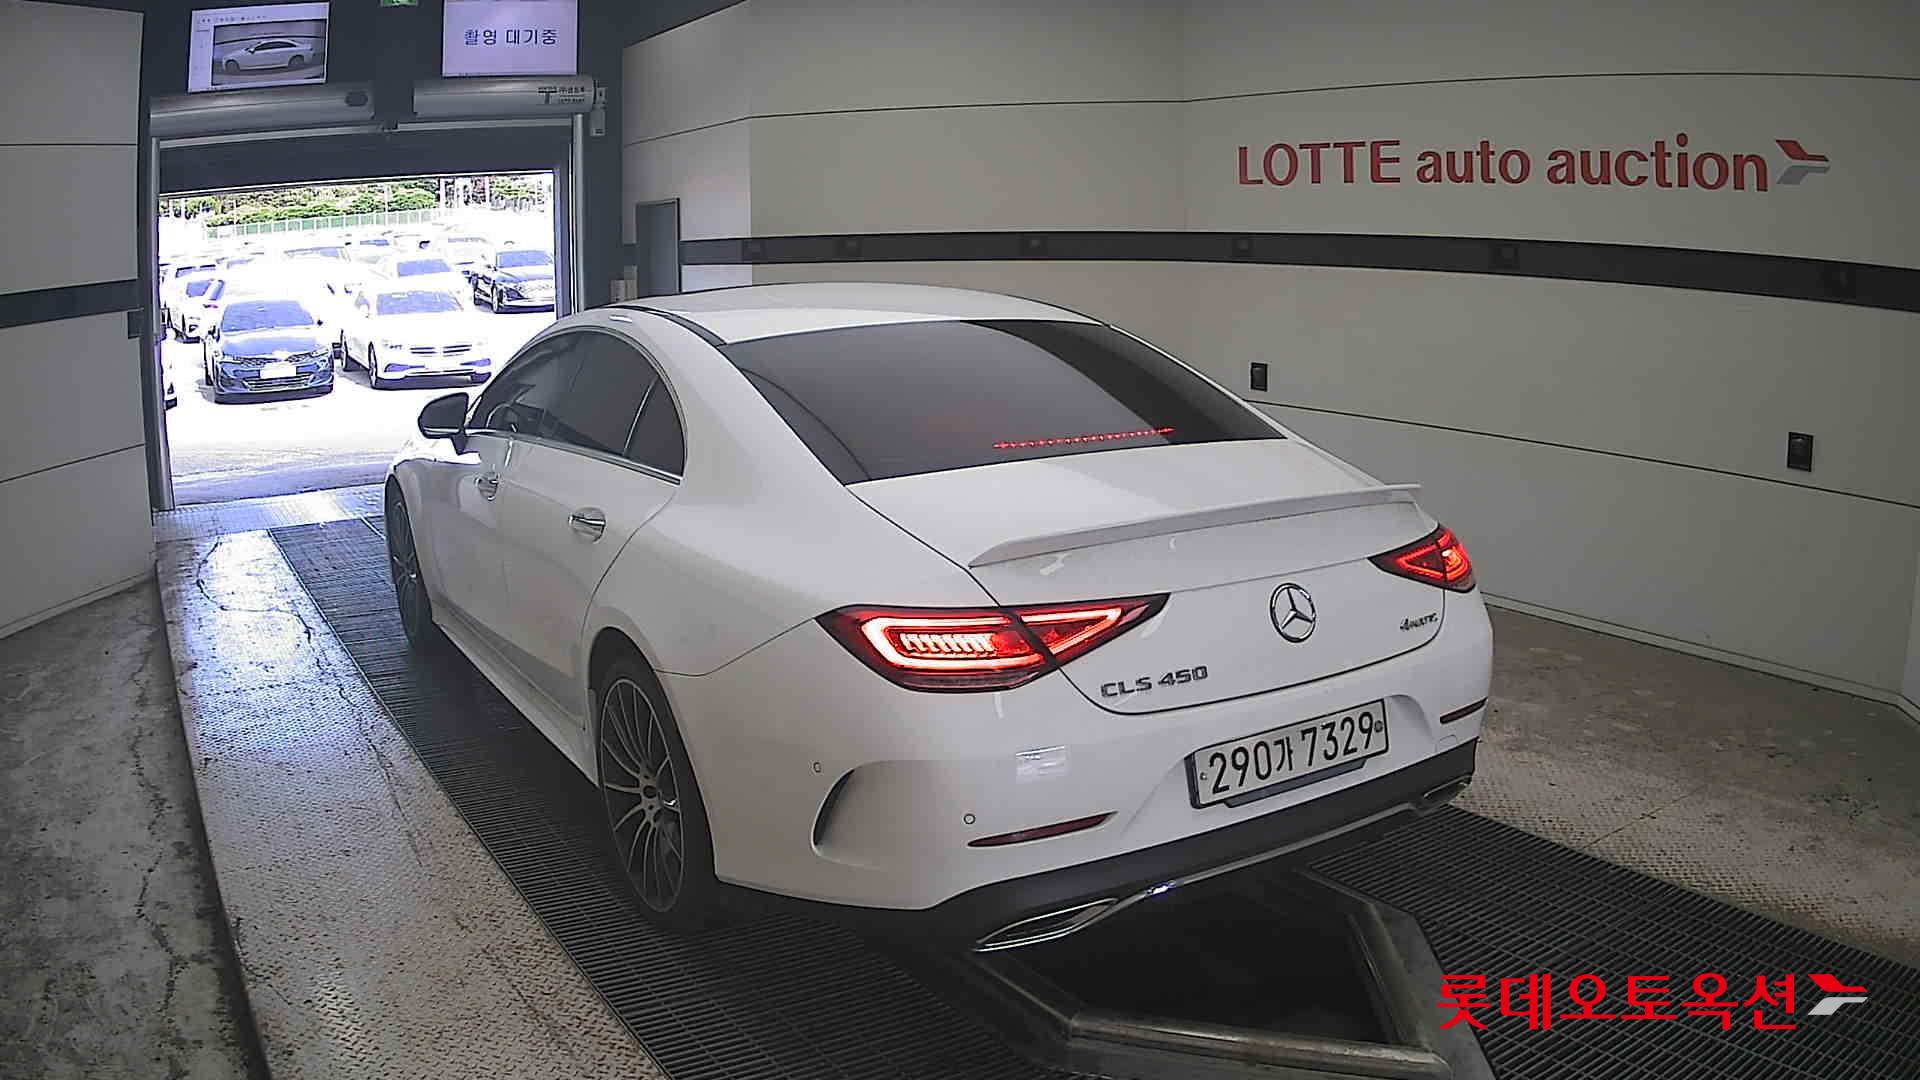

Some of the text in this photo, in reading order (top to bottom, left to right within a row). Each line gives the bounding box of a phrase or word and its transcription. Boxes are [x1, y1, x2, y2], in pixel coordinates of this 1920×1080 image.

[465, 28, 558, 46] 촬영 대기중
[1238, 133, 1768, 191] LOTTE auto auction
[1101, 666, 1208, 697] CLS 450
